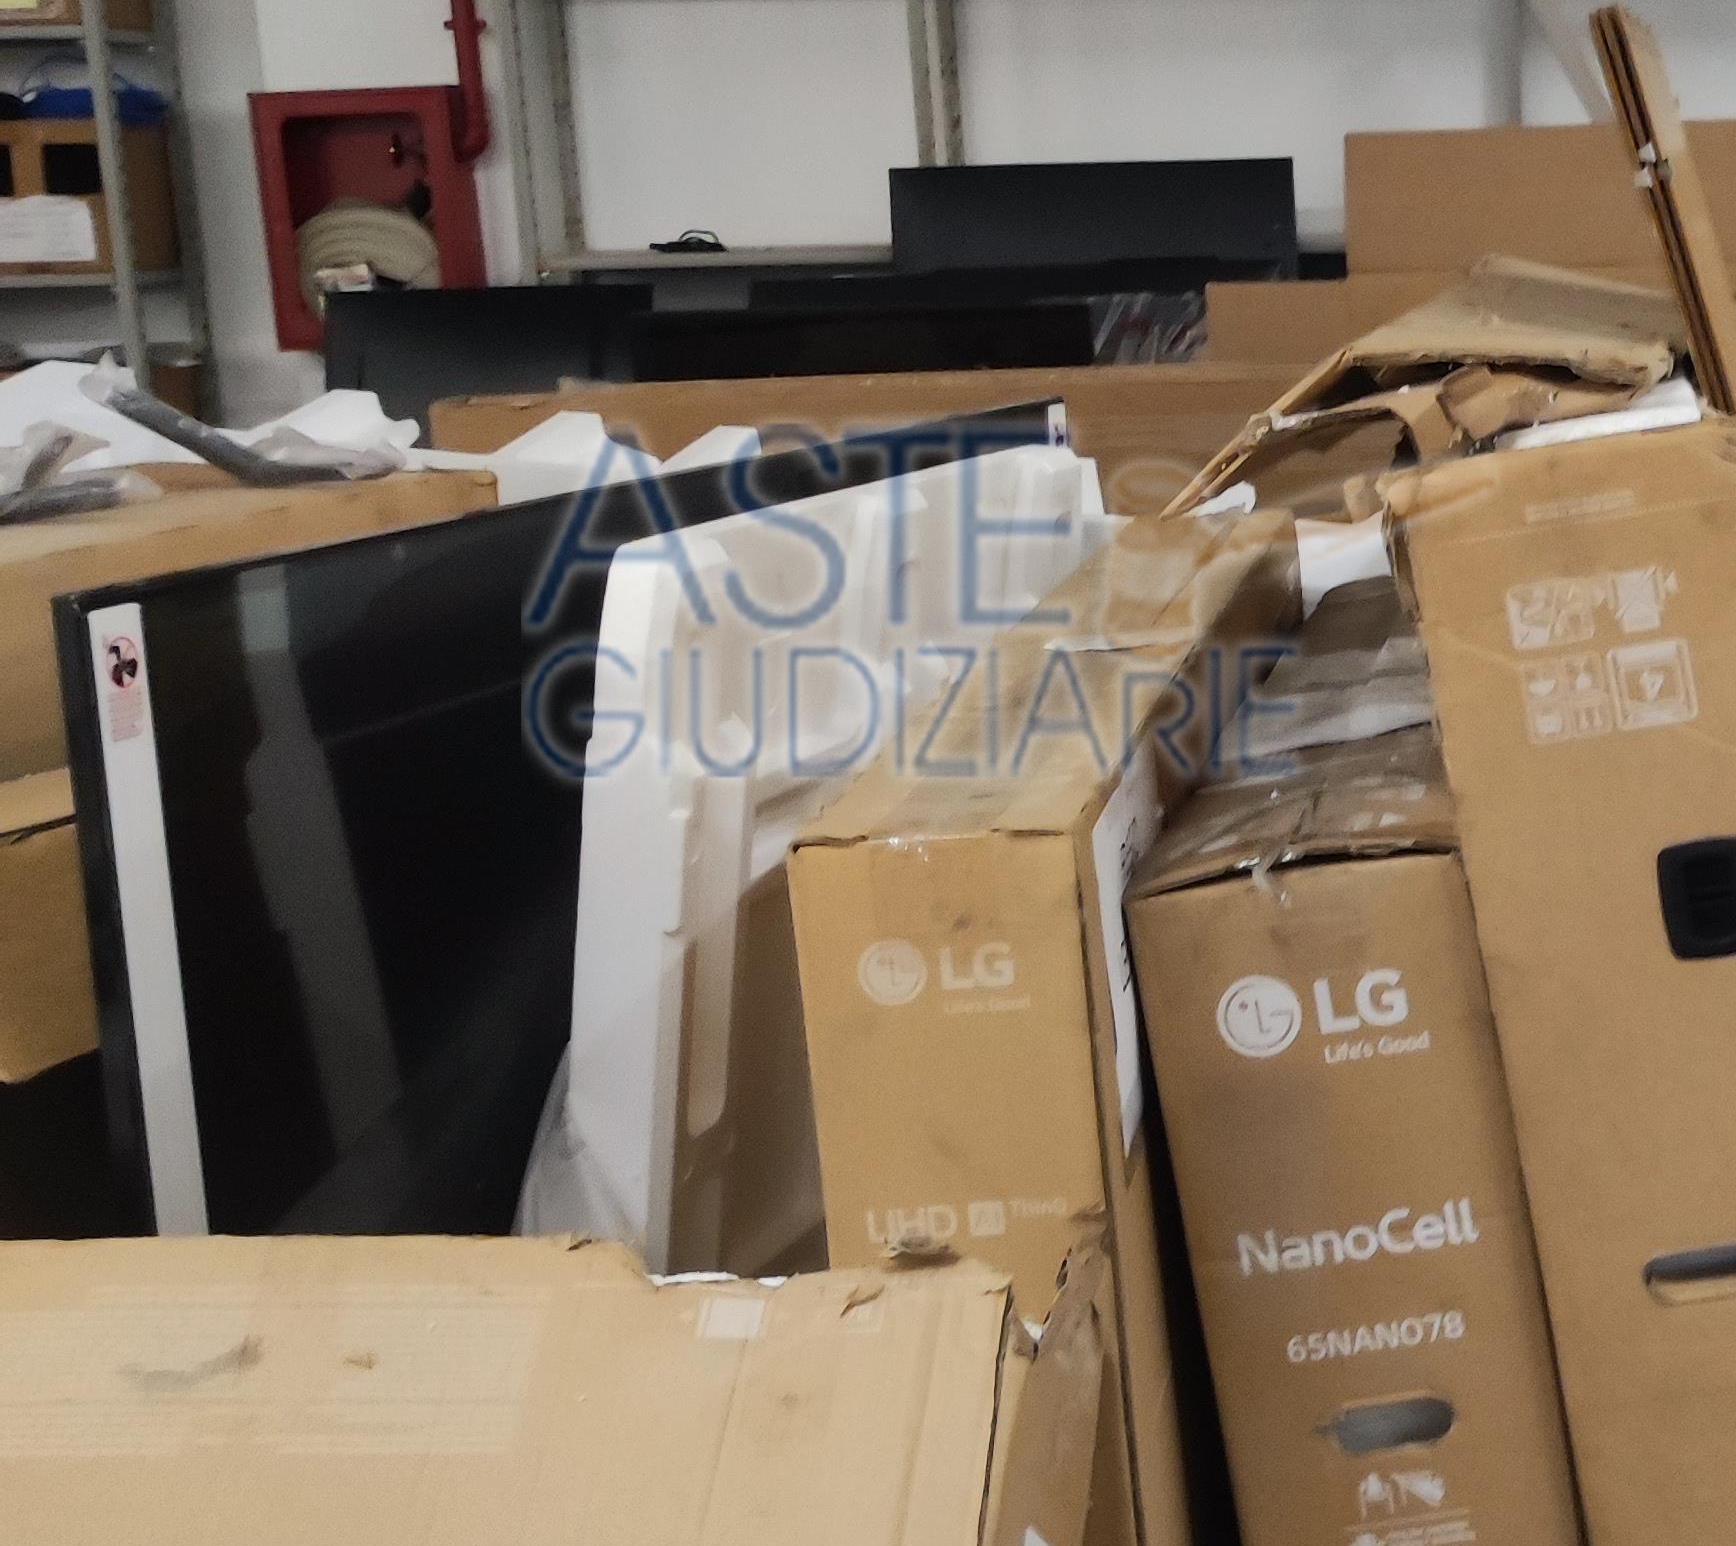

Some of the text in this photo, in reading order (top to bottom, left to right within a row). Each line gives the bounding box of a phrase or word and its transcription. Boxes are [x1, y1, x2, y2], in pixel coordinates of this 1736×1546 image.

[939, 941, 1014, 990] LG
[1314, 968, 1409, 1035] LG
[1237, 1197, 1479, 1276] NanoCell
[1287, 1310, 1466, 1362] 65NANO78
